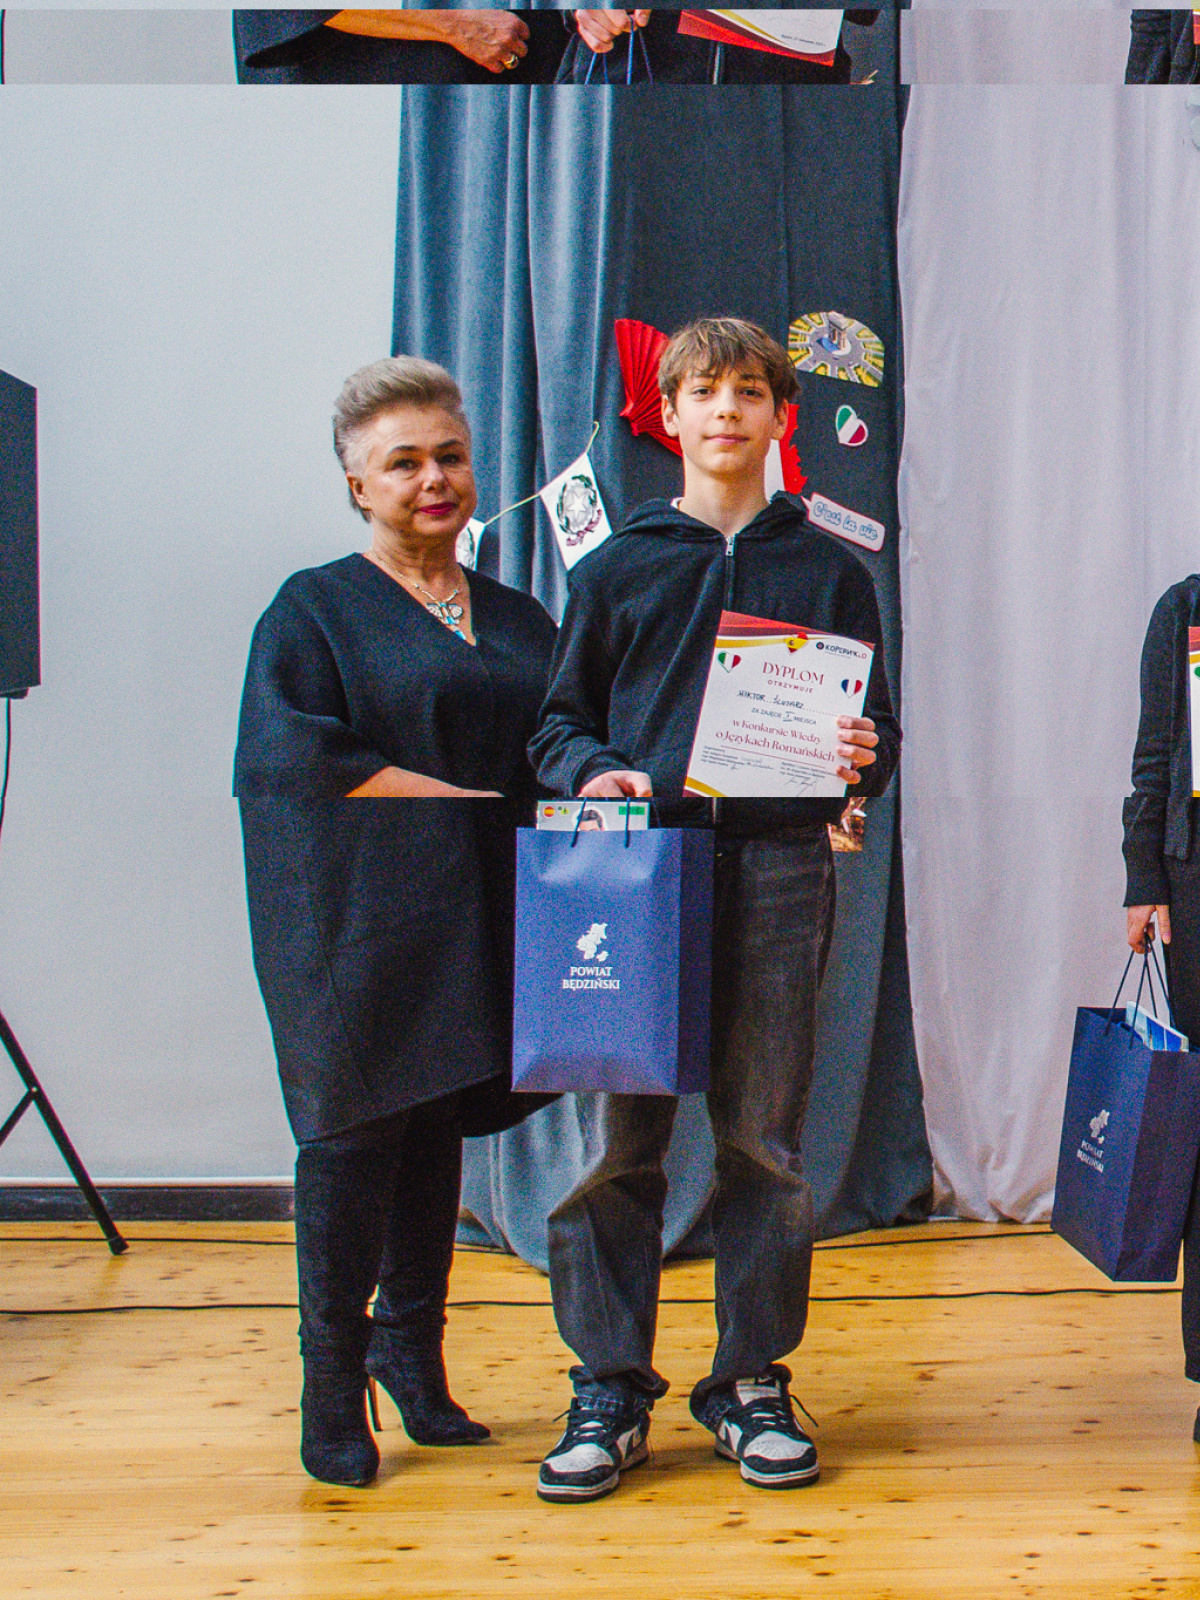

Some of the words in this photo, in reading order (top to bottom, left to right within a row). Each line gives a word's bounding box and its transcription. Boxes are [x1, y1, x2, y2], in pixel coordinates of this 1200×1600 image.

[843, 515, 857, 532] la
[859, 524, 878, 541] vie
[762, 661, 825, 686] DYPLOM
[767, 679, 814, 694] OTRZYMUJE
[793, 716, 817, 725] MIEJSCA
[741, 720, 789, 737] Konkursie
[790, 729, 821, 745] Wiedzy
[725, 731, 770, 748] Językach
[771, 740, 835, 762] Romańskich
[570, 966, 613, 977] POWIAT
[562, 977, 621, 991] BĘDZIŃSKI
